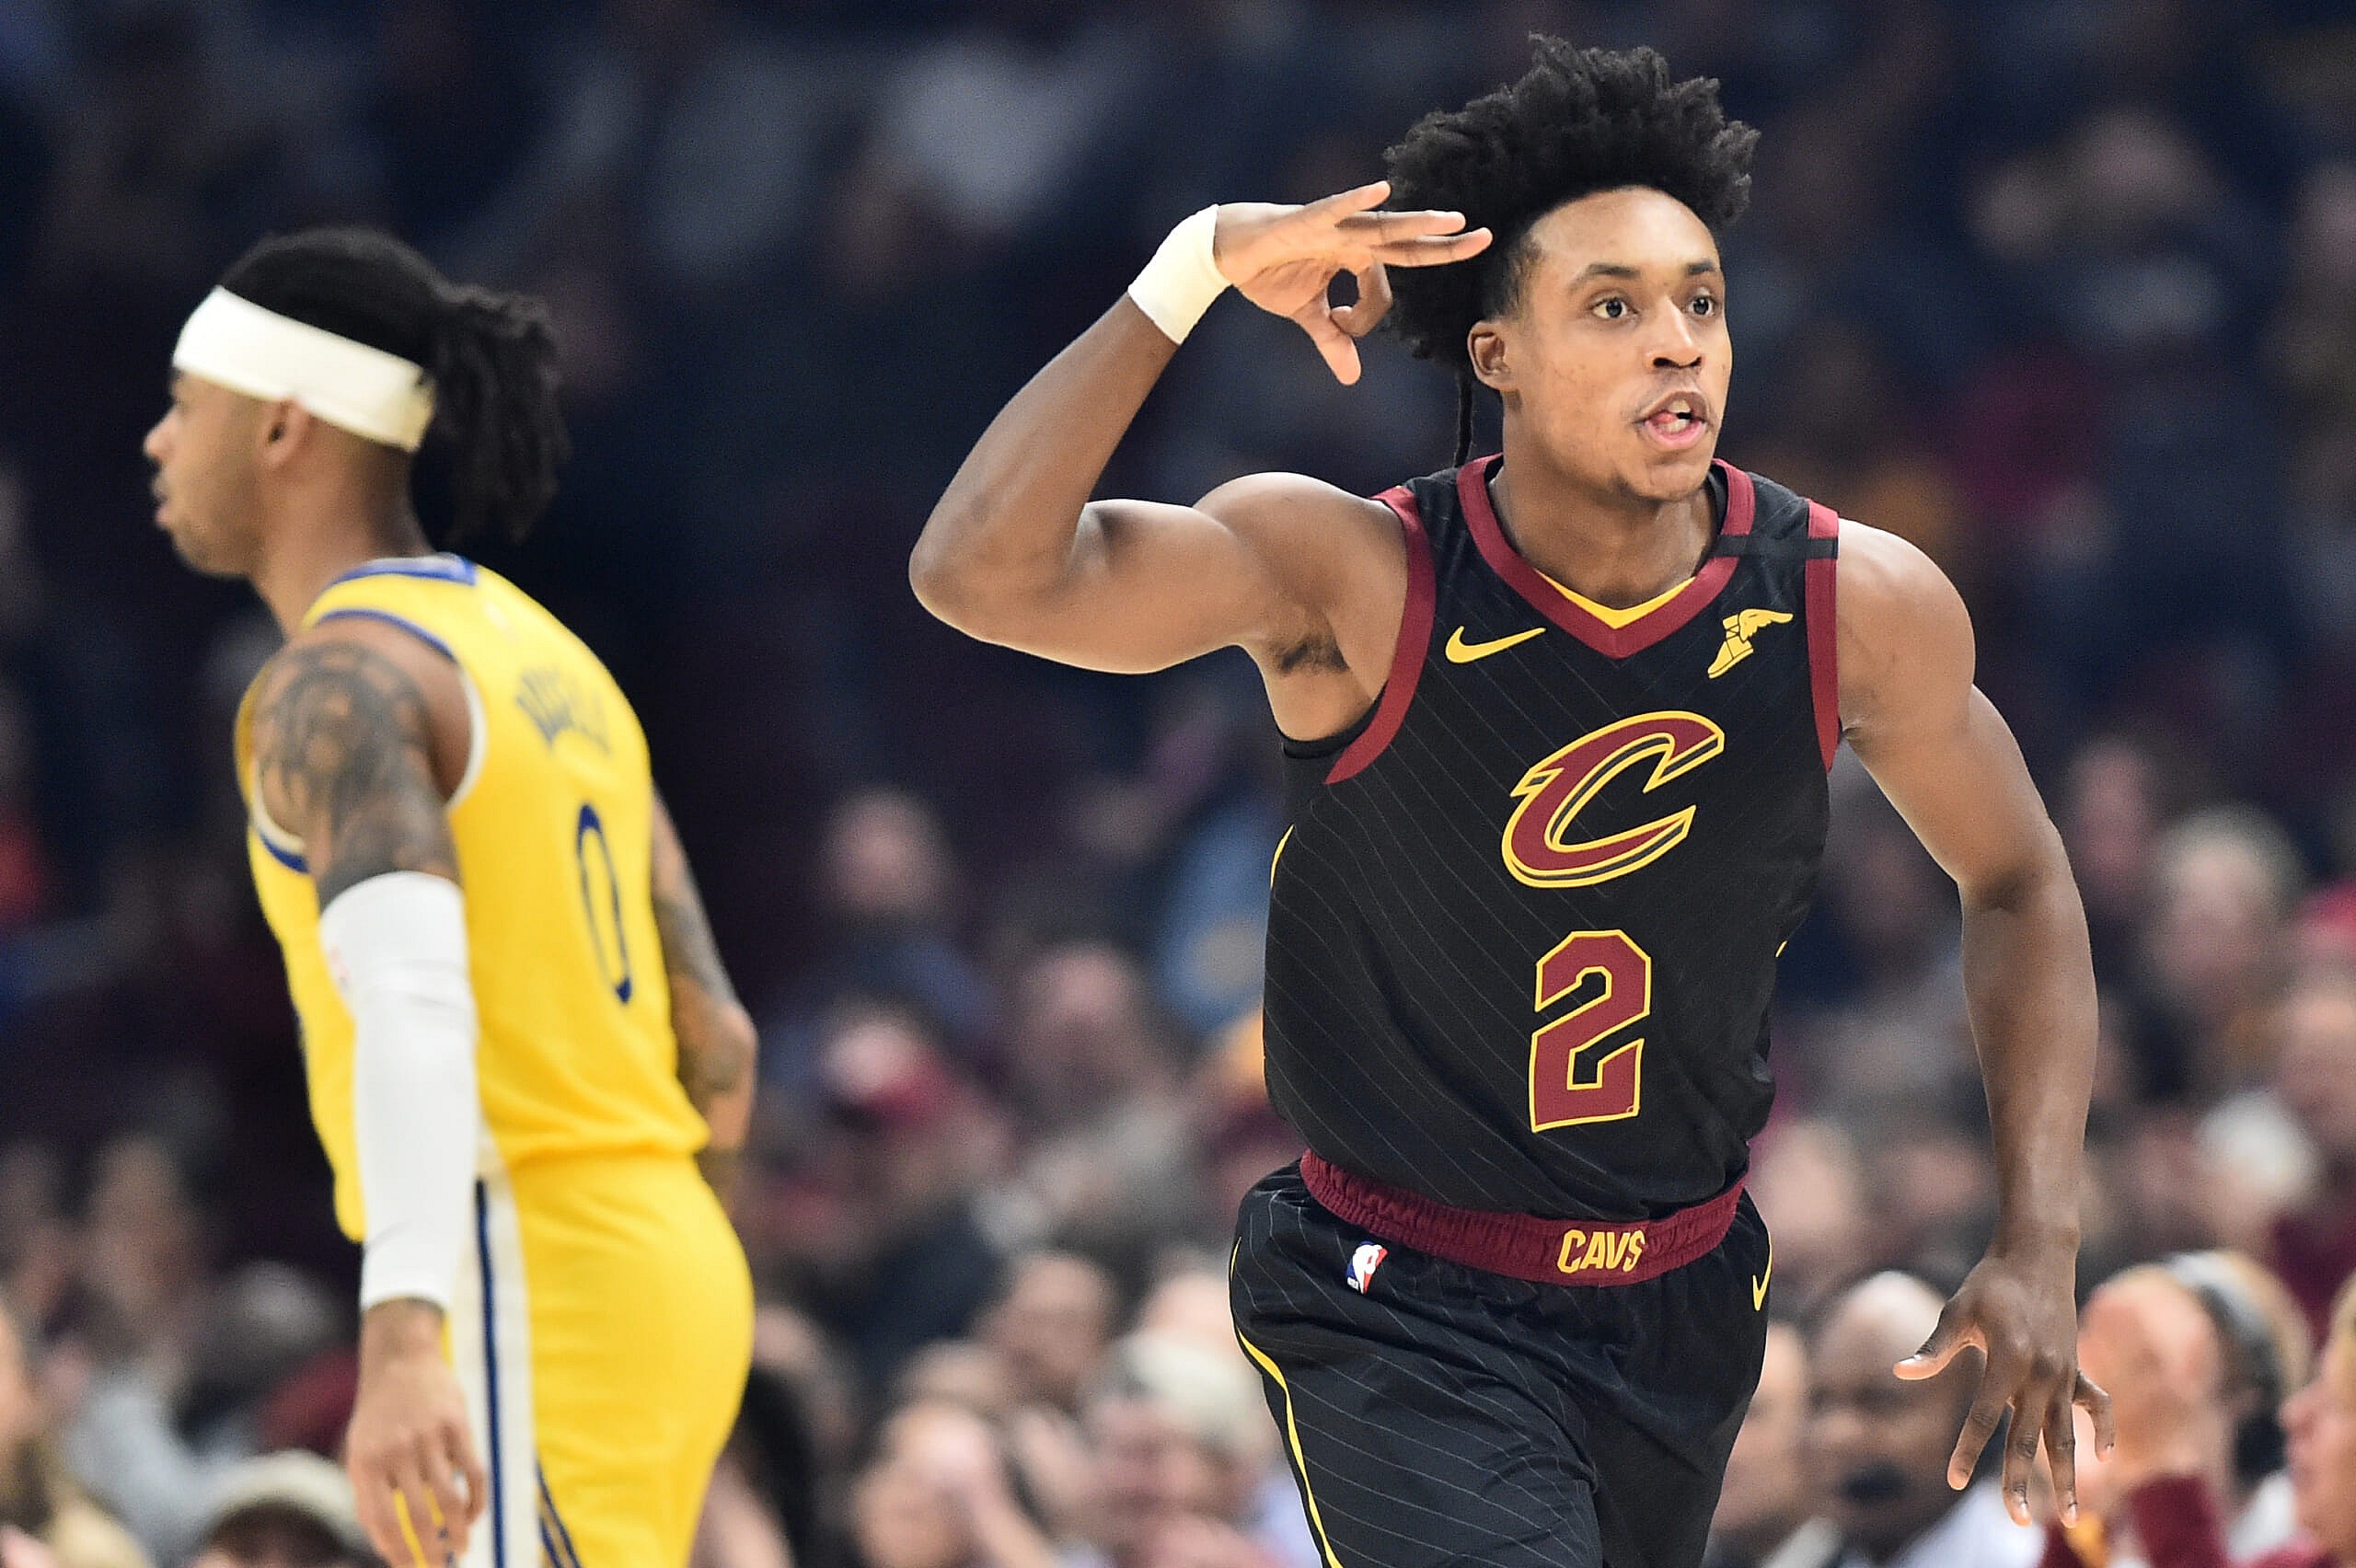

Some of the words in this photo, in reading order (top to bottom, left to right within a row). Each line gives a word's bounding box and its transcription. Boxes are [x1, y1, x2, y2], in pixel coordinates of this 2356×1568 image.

[1502, 709, 1725, 889] C
[576, 803, 632, 1004] 0
[1529, 929, 1652, 1134] 2
[1556, 1228, 1646, 1274] CAVS
